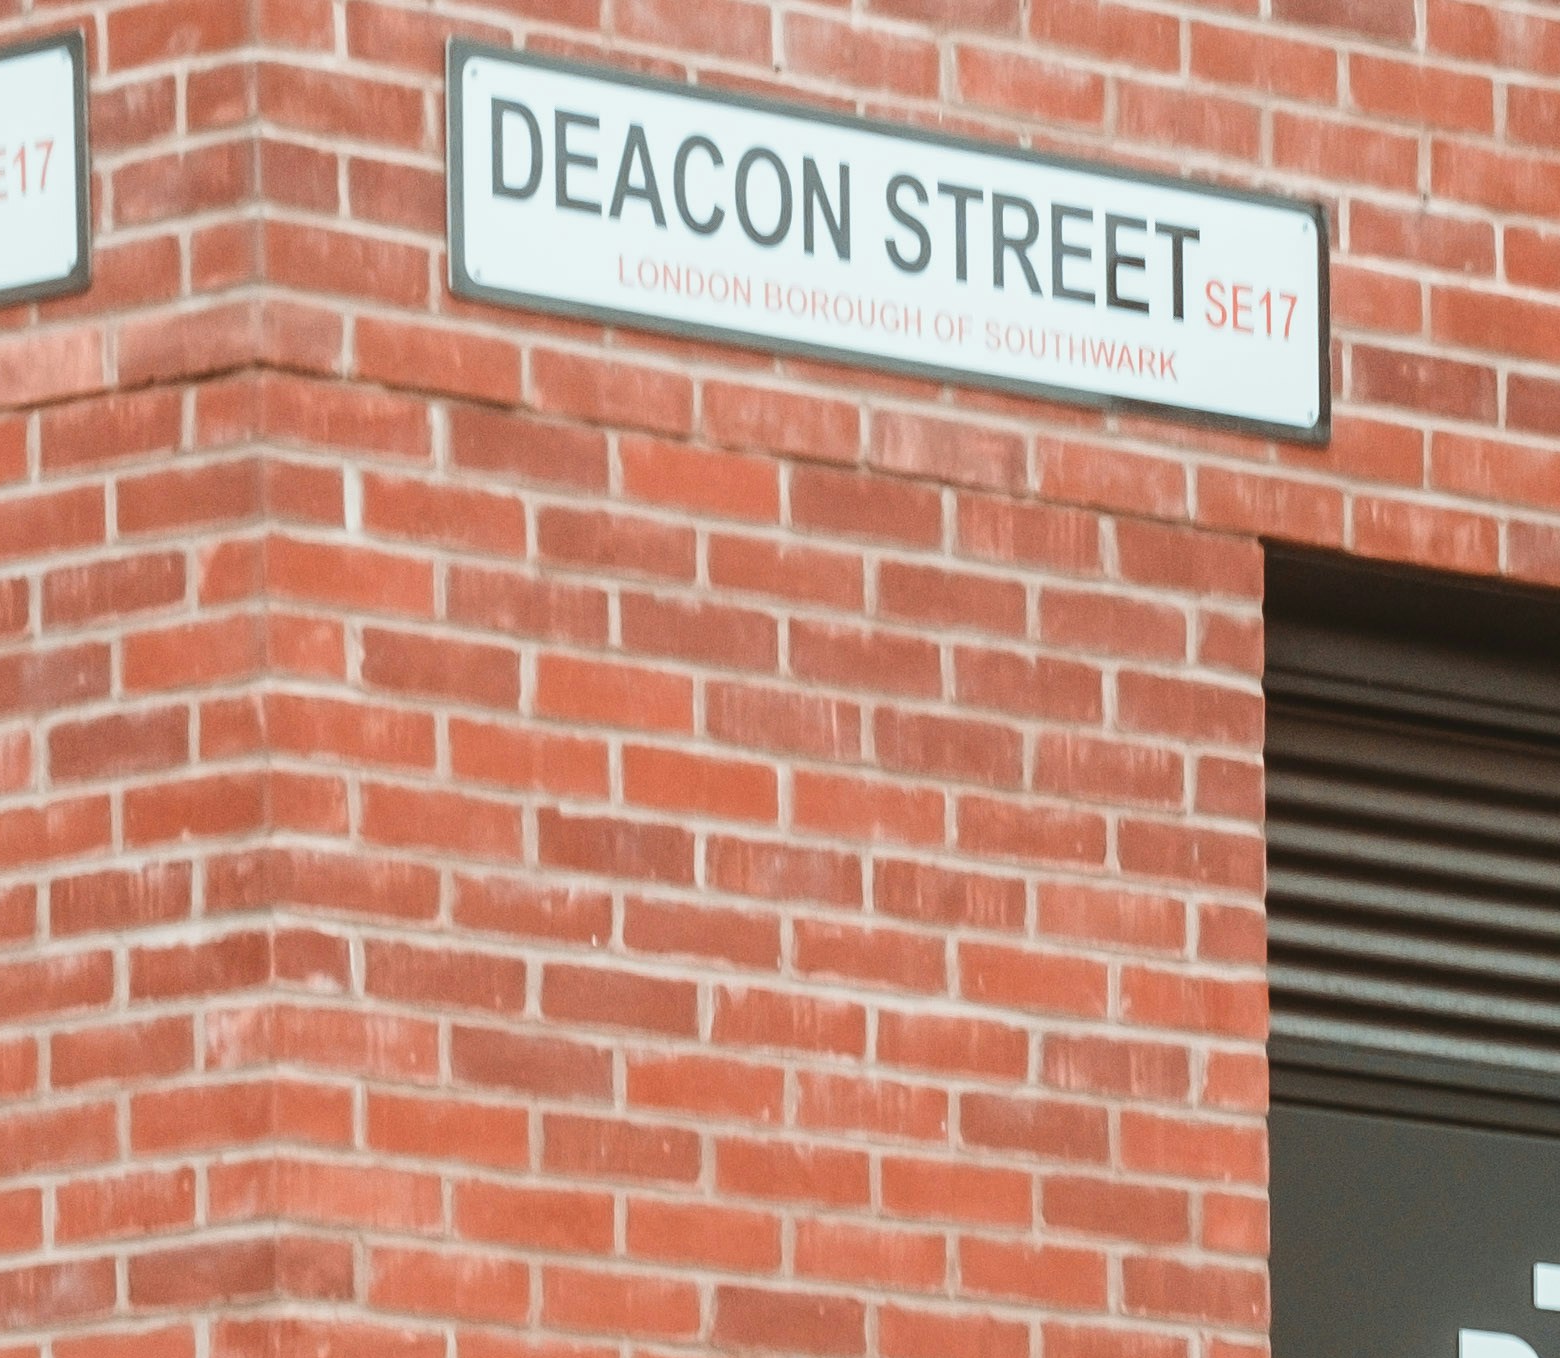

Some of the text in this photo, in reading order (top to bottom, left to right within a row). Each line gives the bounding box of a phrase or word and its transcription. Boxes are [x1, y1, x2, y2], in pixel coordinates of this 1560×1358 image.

[490, 97, 1298, 342] DEACON STREET SE17
[618, 253, 1178, 383] LONDON BOROUGH OF SOUTHWARK
